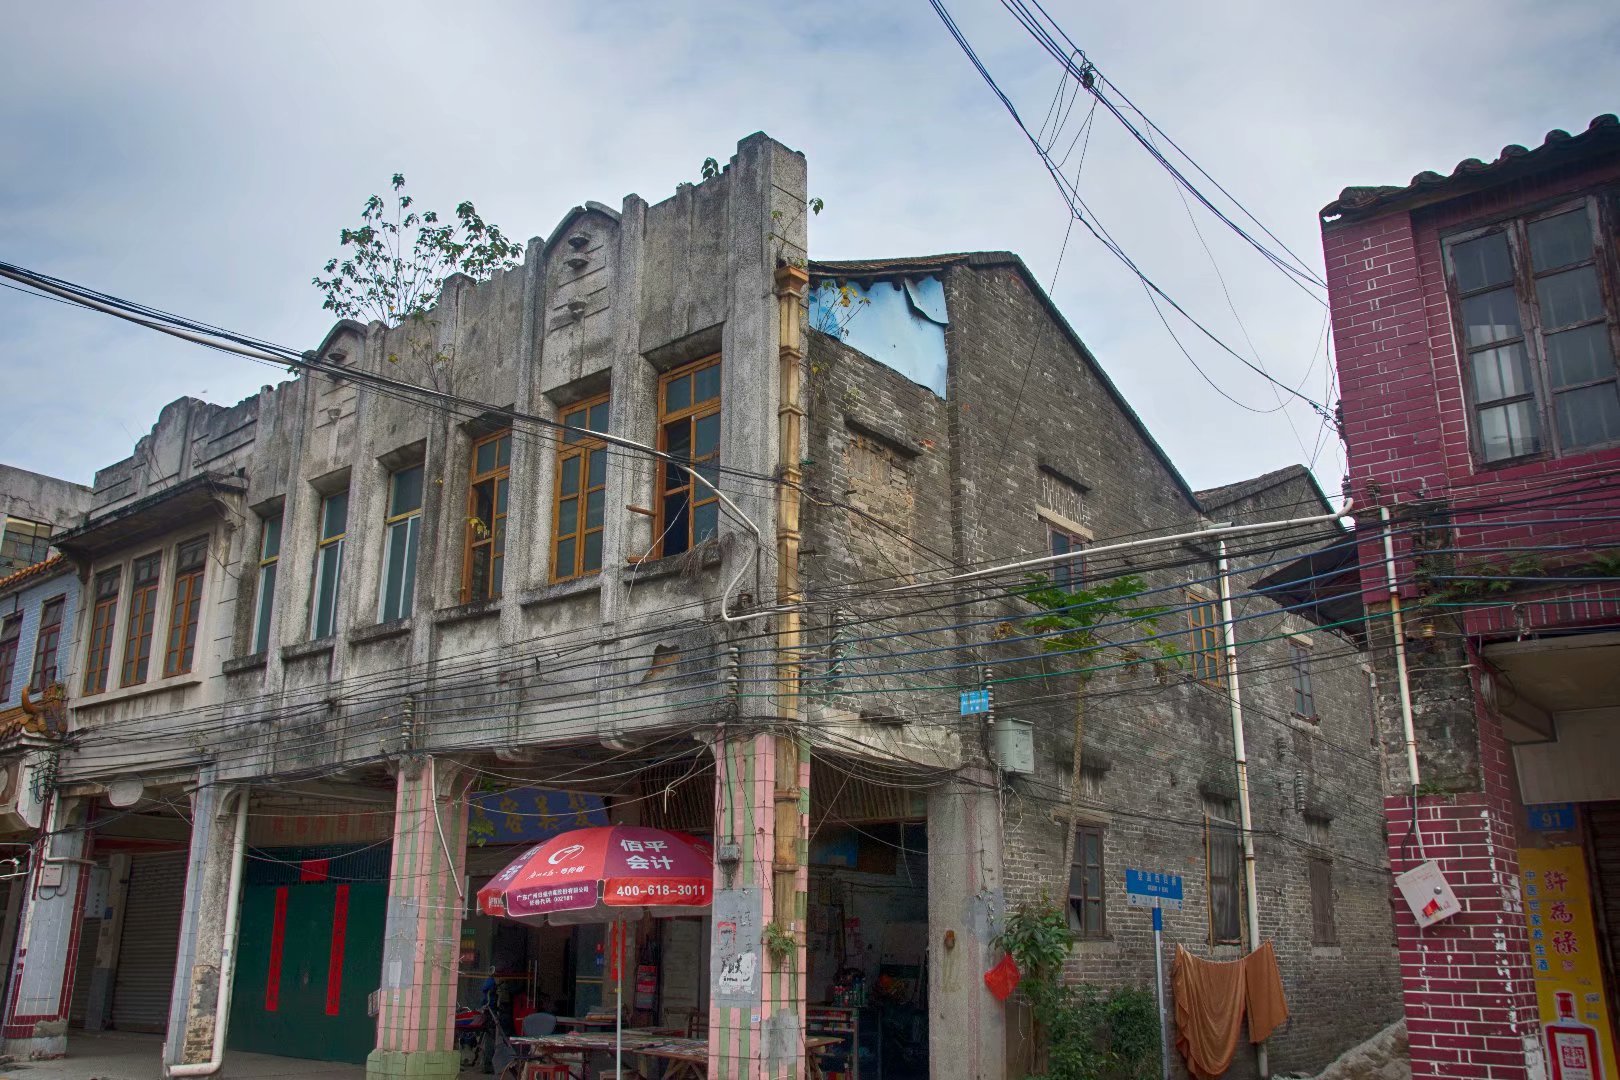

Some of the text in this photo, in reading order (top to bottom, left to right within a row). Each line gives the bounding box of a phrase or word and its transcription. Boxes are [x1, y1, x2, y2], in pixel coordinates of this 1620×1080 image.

[1542, 812, 1561, 827] 91
[621, 839, 668, 853] 佰平
[626, 854, 673, 870] 会计
[616, 884, 705, 897] 400-618-3011
[1525, 870, 1549, 971] 中医世家养生酒
